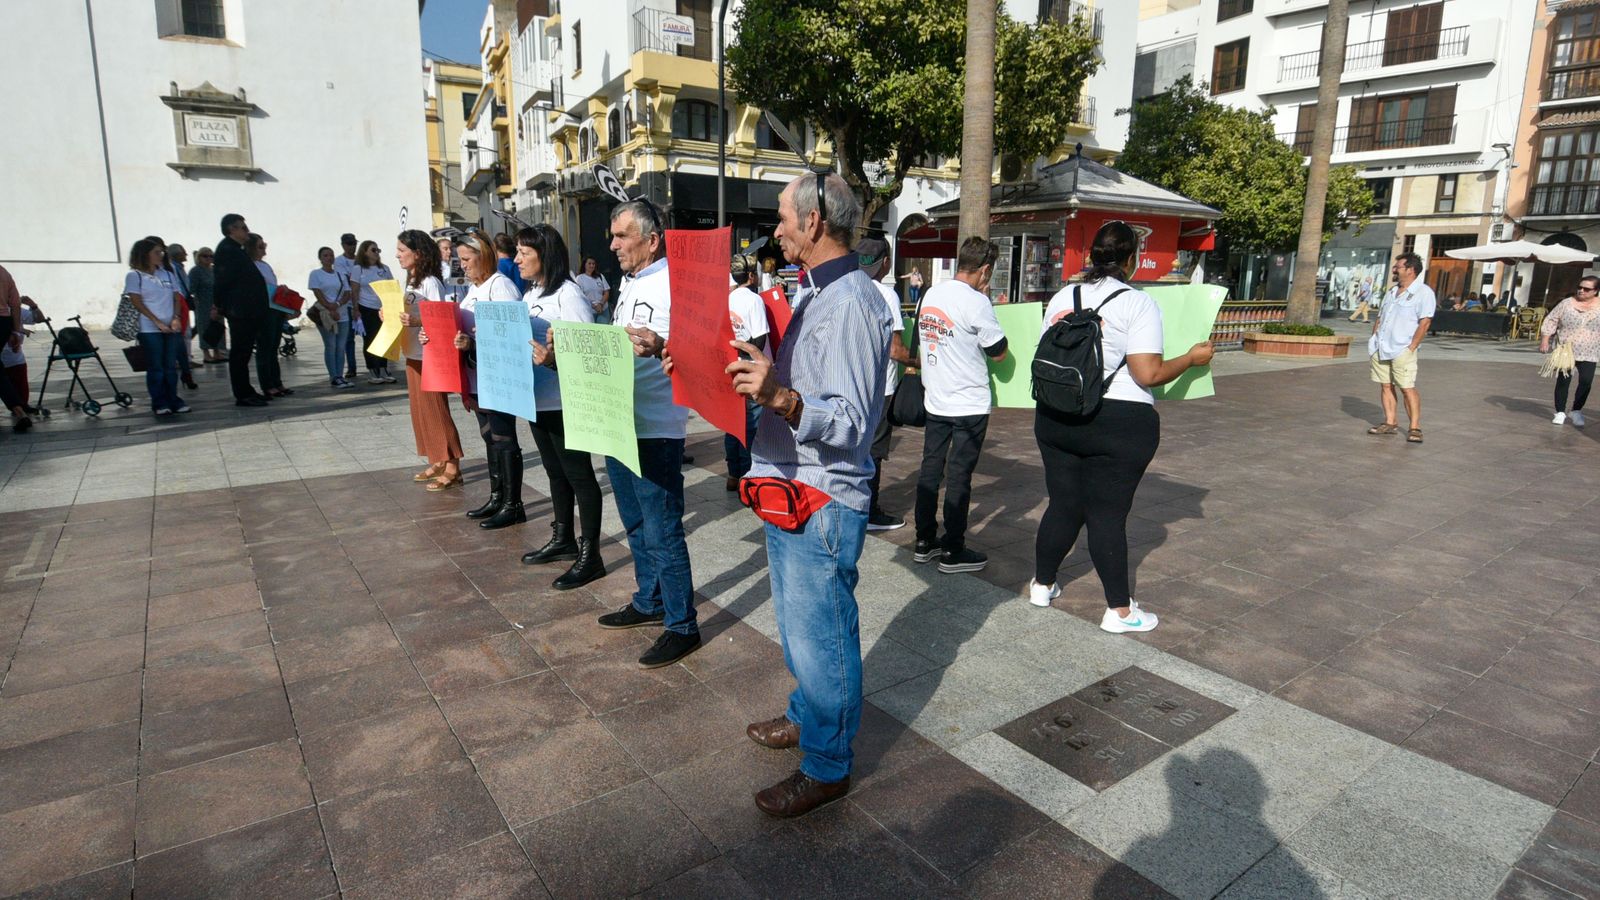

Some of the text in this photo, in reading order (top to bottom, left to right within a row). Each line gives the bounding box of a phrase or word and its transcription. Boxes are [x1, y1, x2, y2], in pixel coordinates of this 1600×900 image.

[192, 120, 230, 132] PLAZA
[198, 132, 227, 142] ALTA
[1141, 258, 1156, 269] Alta
[920, 314, 937, 324] UERA
[919, 322, 954, 338] BERTURA
[1122, 688, 1162, 708] POR
[1169, 708, 1205, 728] 100
[1092, 744, 1126, 762] 15
